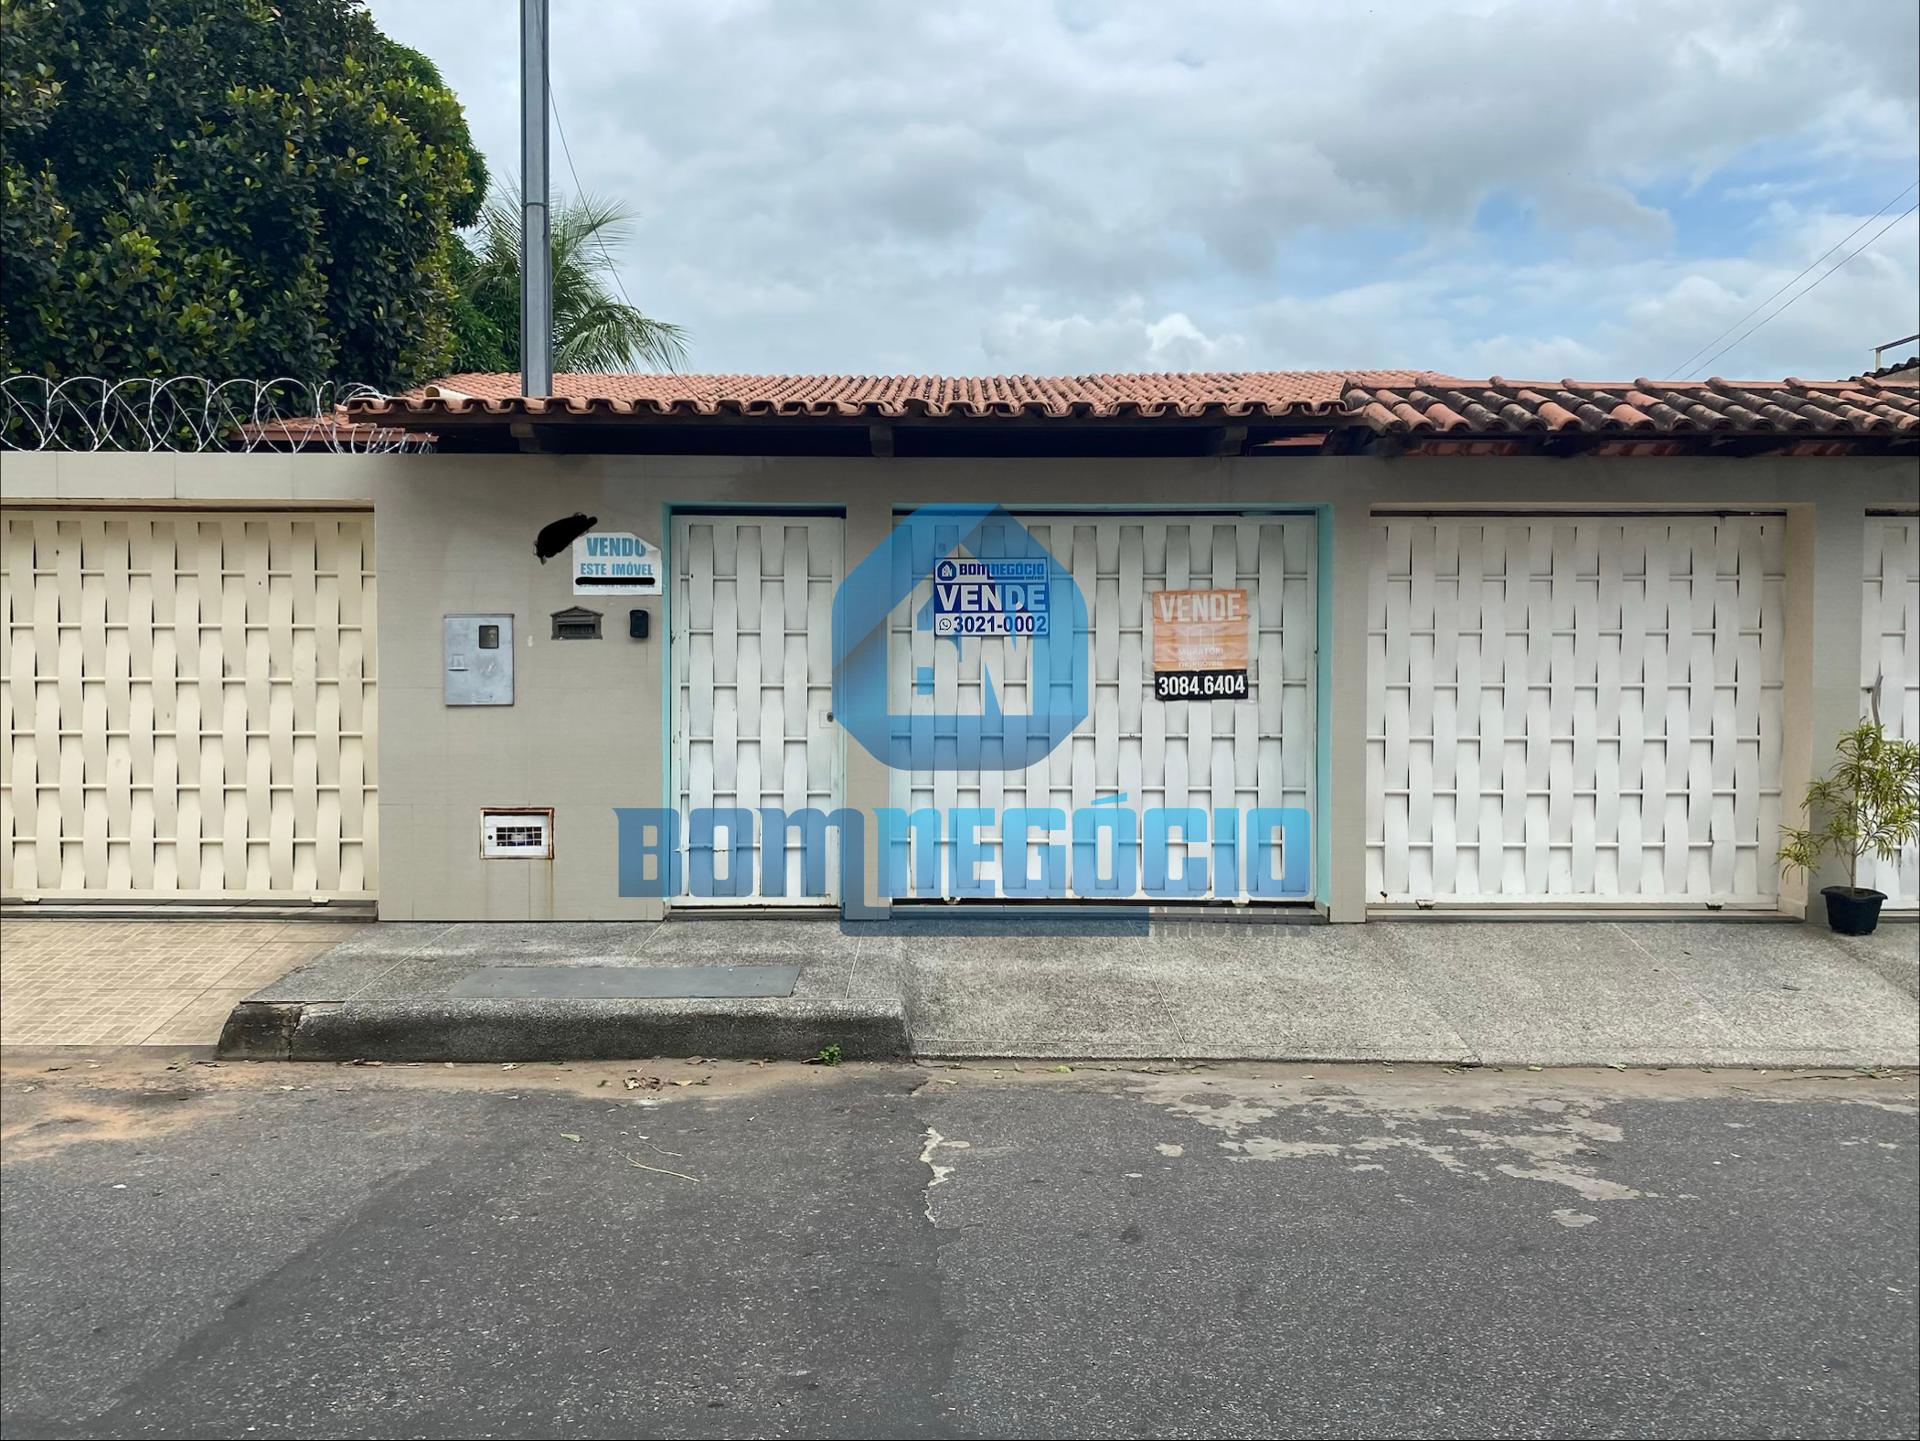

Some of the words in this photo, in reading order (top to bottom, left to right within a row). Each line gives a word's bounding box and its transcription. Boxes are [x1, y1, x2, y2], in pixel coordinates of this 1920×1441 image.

[586, 537, 647, 557] VENDO
[580, 563, 607, 575] ESTE
[611, 561, 653, 576] IMÓVEL
[958, 563, 991, 577] BOM
[936, 584, 1046, 612] VENDE
[1159, 593, 1242, 623] VENDE
[953, 615, 1047, 633] 3021-0002
[1158, 674, 1246, 696] 3084.6404
